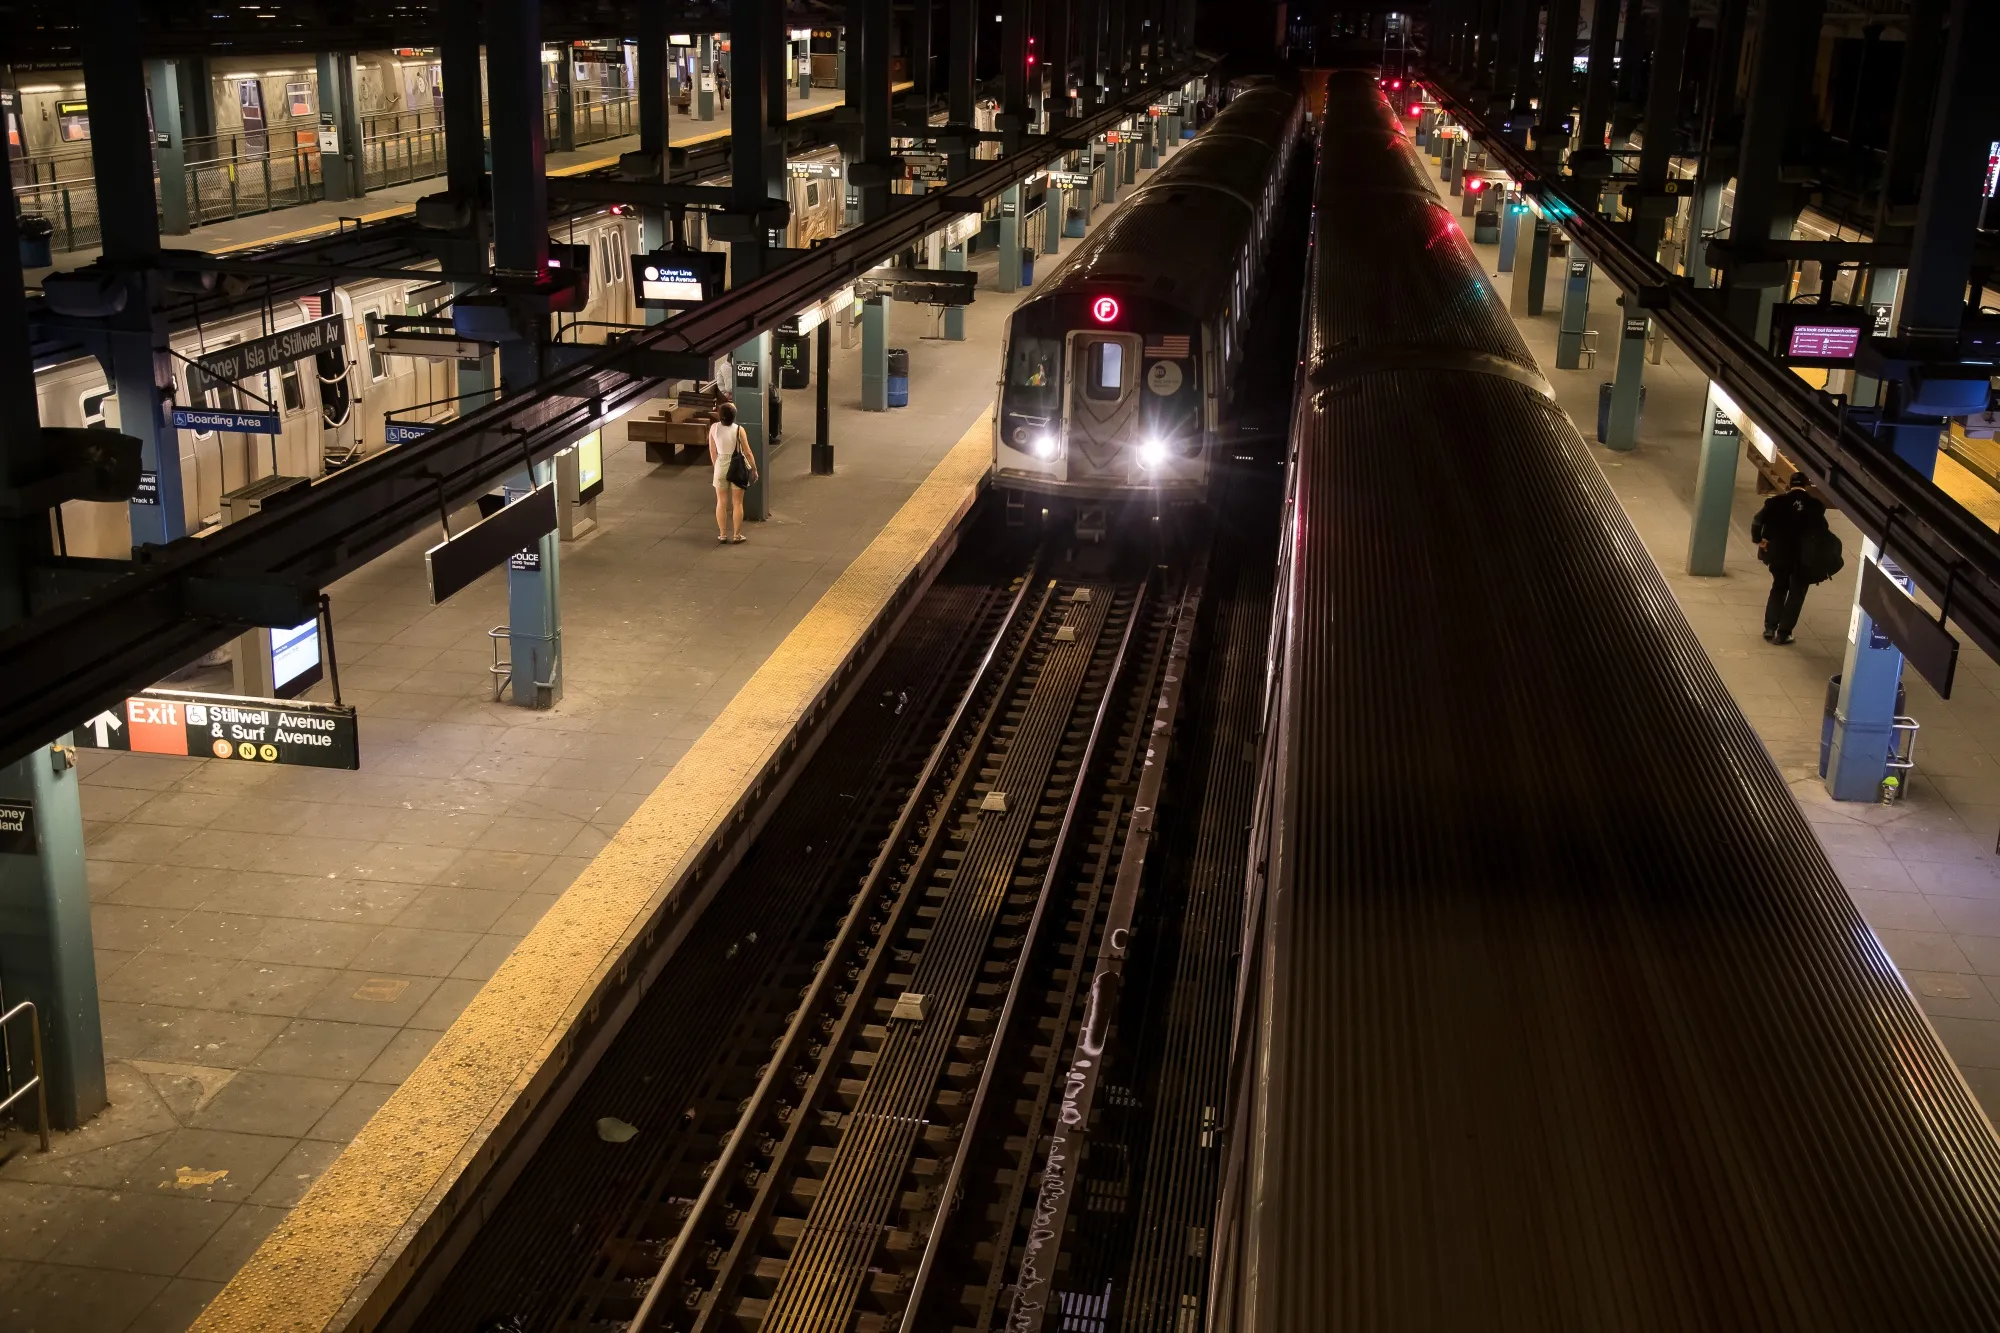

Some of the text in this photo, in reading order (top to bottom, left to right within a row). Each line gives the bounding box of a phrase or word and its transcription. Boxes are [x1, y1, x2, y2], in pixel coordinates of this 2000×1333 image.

[200, 357, 240, 383] Coney
[326, 322, 339, 344] Av
[738, 366, 755, 374] Coney
[187, 414, 261, 427] Boarding Area
[128, 702, 336, 731] Exit Stillwell Avenue
[211, 724, 332, 747] & Surf Avenue
